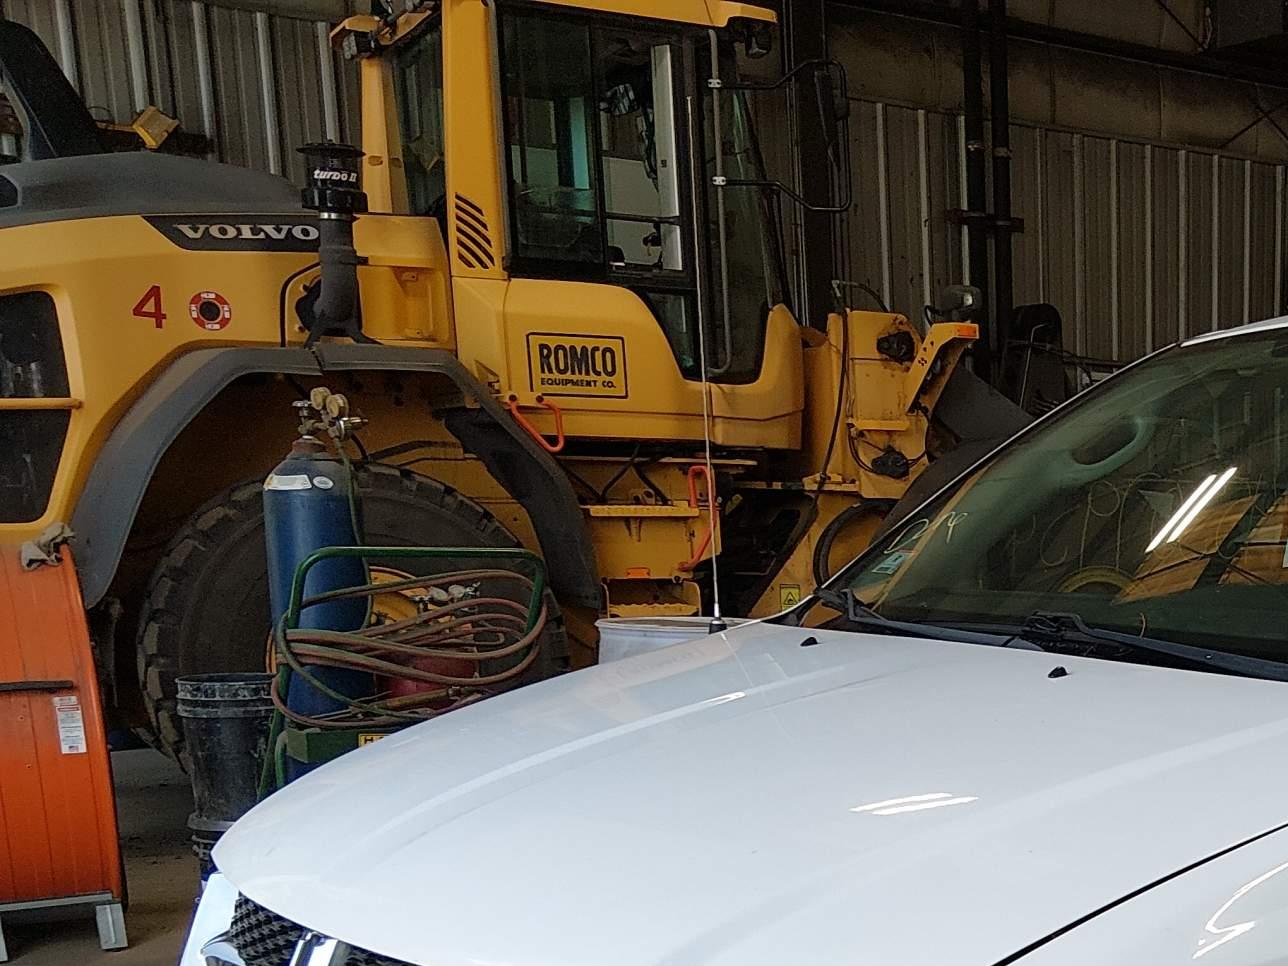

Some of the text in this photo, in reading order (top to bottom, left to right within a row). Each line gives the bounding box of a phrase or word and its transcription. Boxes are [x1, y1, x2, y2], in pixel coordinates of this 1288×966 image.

[173, 223, 320, 240] VOLVO
[132, 284, 167, 329] 4
[538, 343, 617, 378] ROMCO
[540, 378, 598, 388] EQUIPMENT
